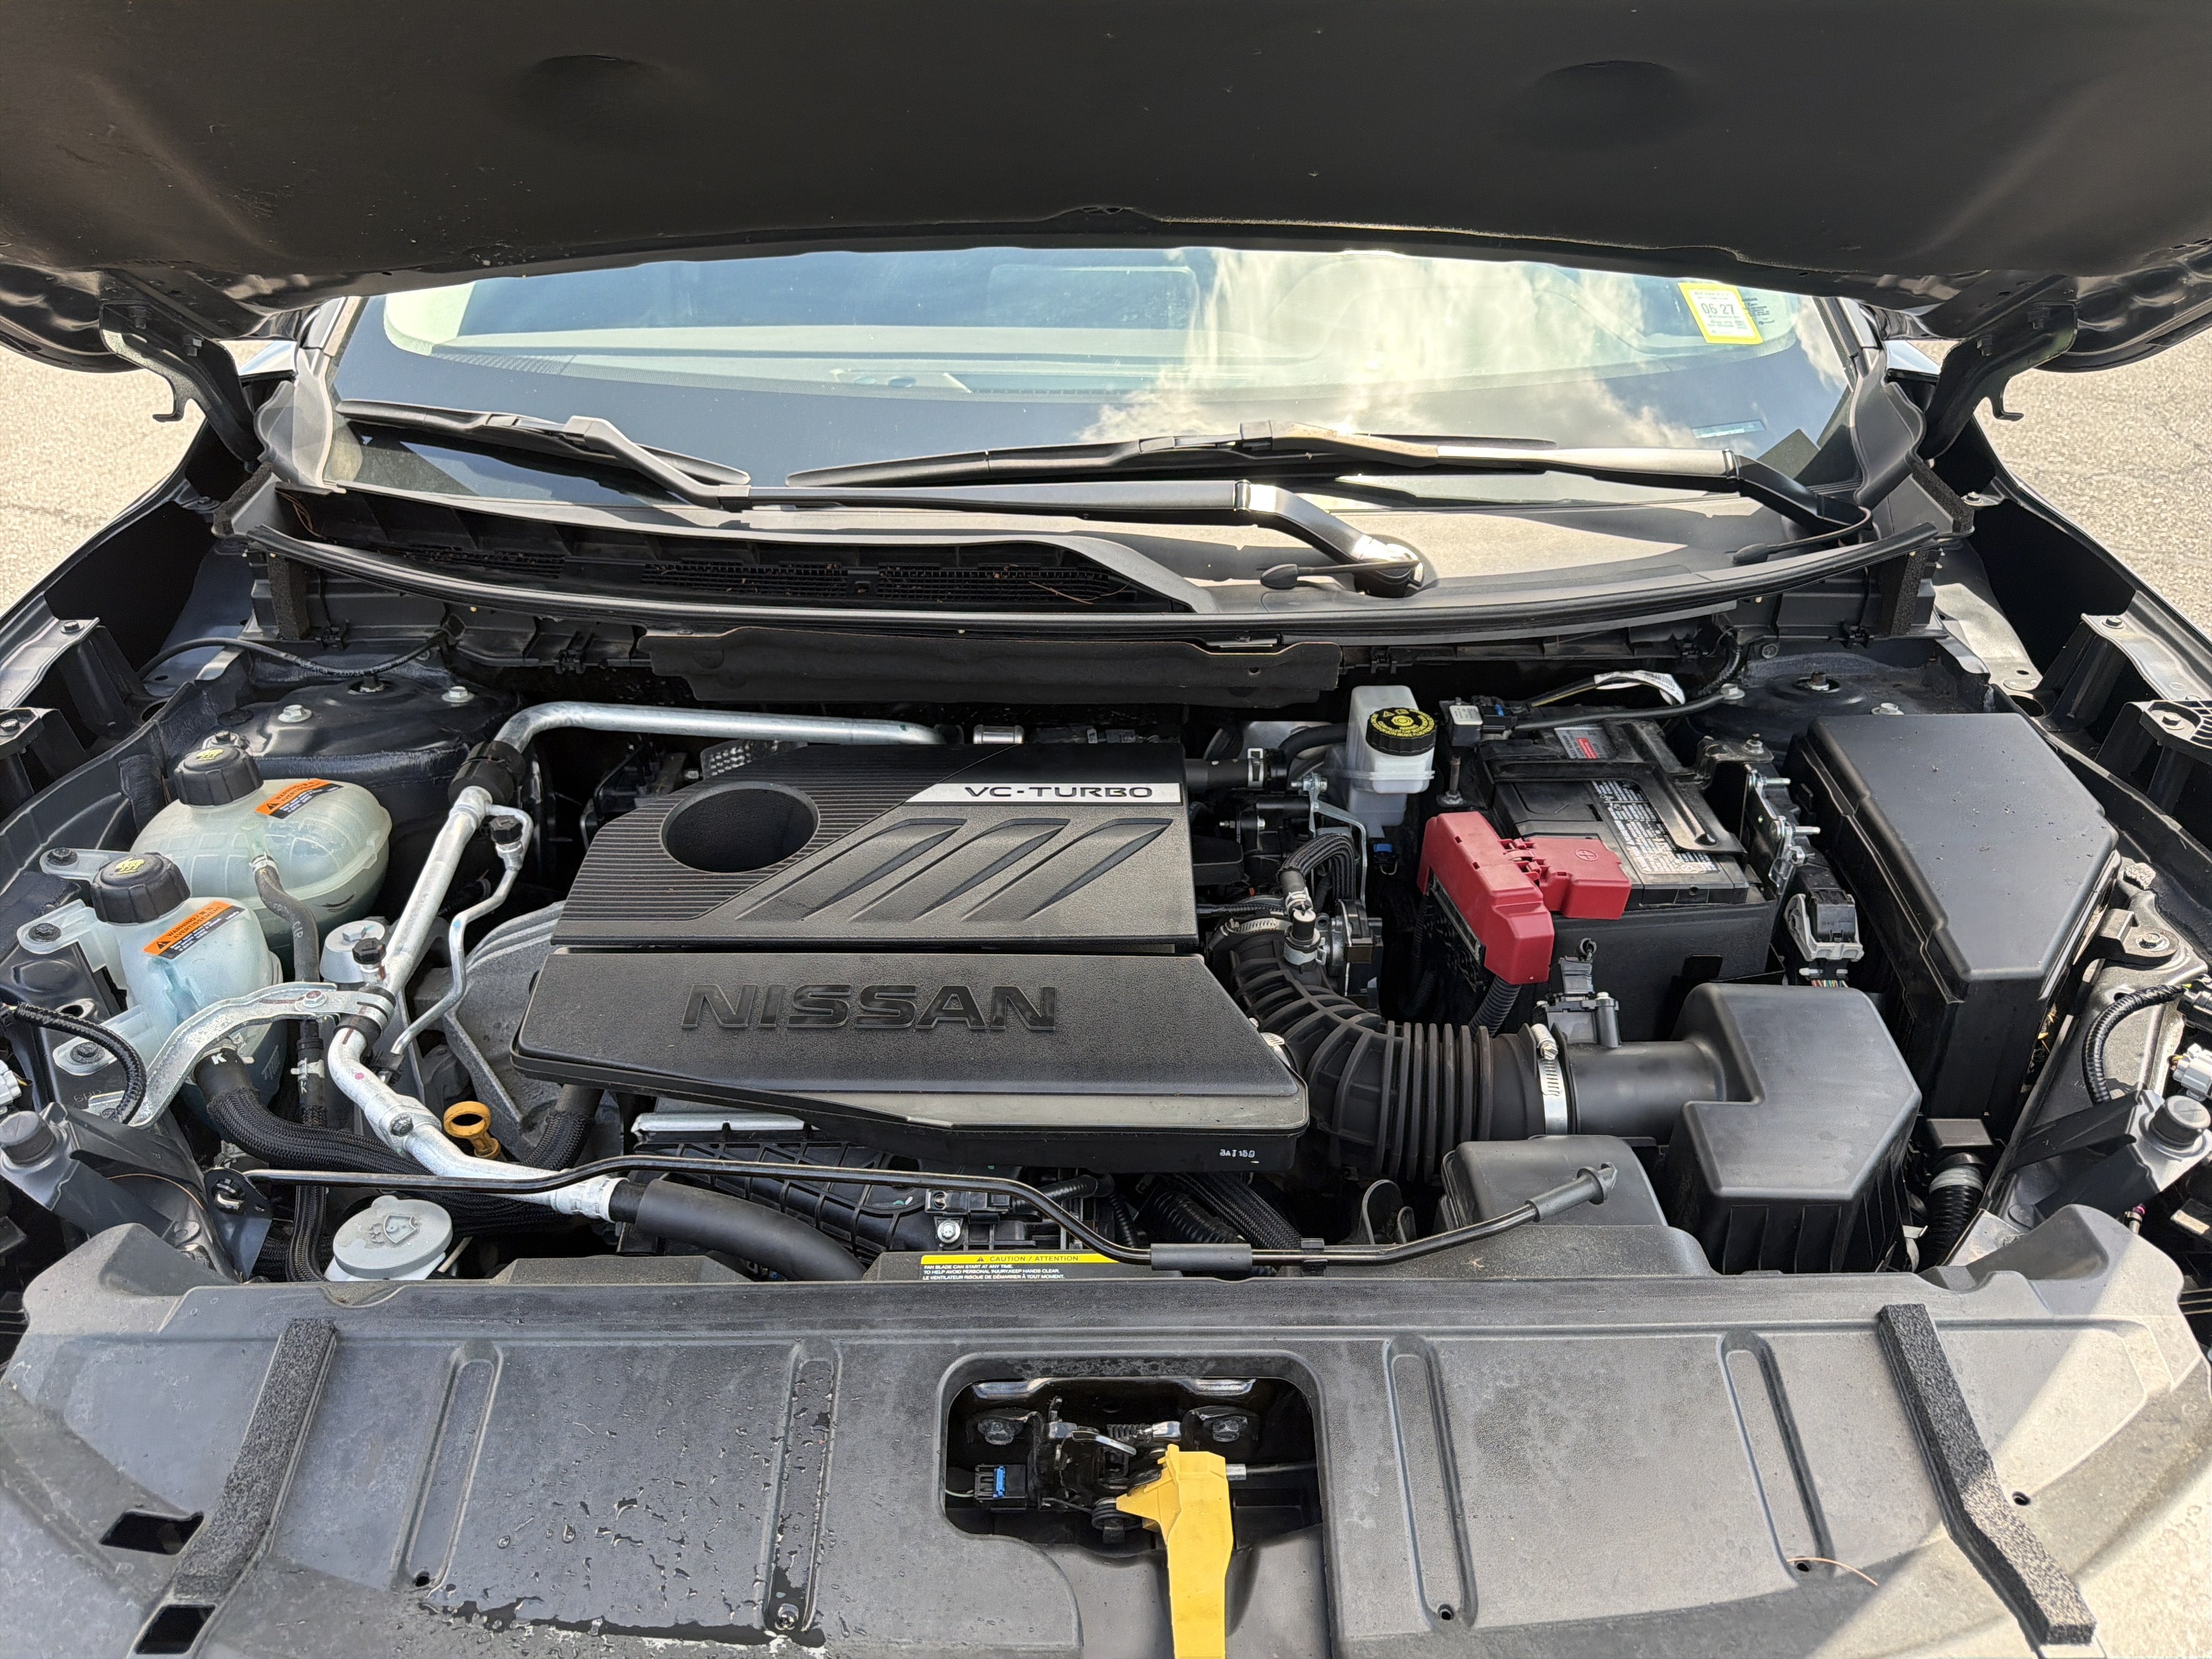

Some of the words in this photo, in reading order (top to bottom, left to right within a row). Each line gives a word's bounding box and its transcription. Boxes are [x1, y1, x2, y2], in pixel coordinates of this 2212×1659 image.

[1701, 303, 1718, 314] 06
[1719, 304, 1735, 315] 27
[964, 786, 1153, 798] VC-TURBO
[166, 917, 197, 937] WARNING
[680, 984, 1057, 1031] NISSAN
[211, 1052, 228, 1065] K
